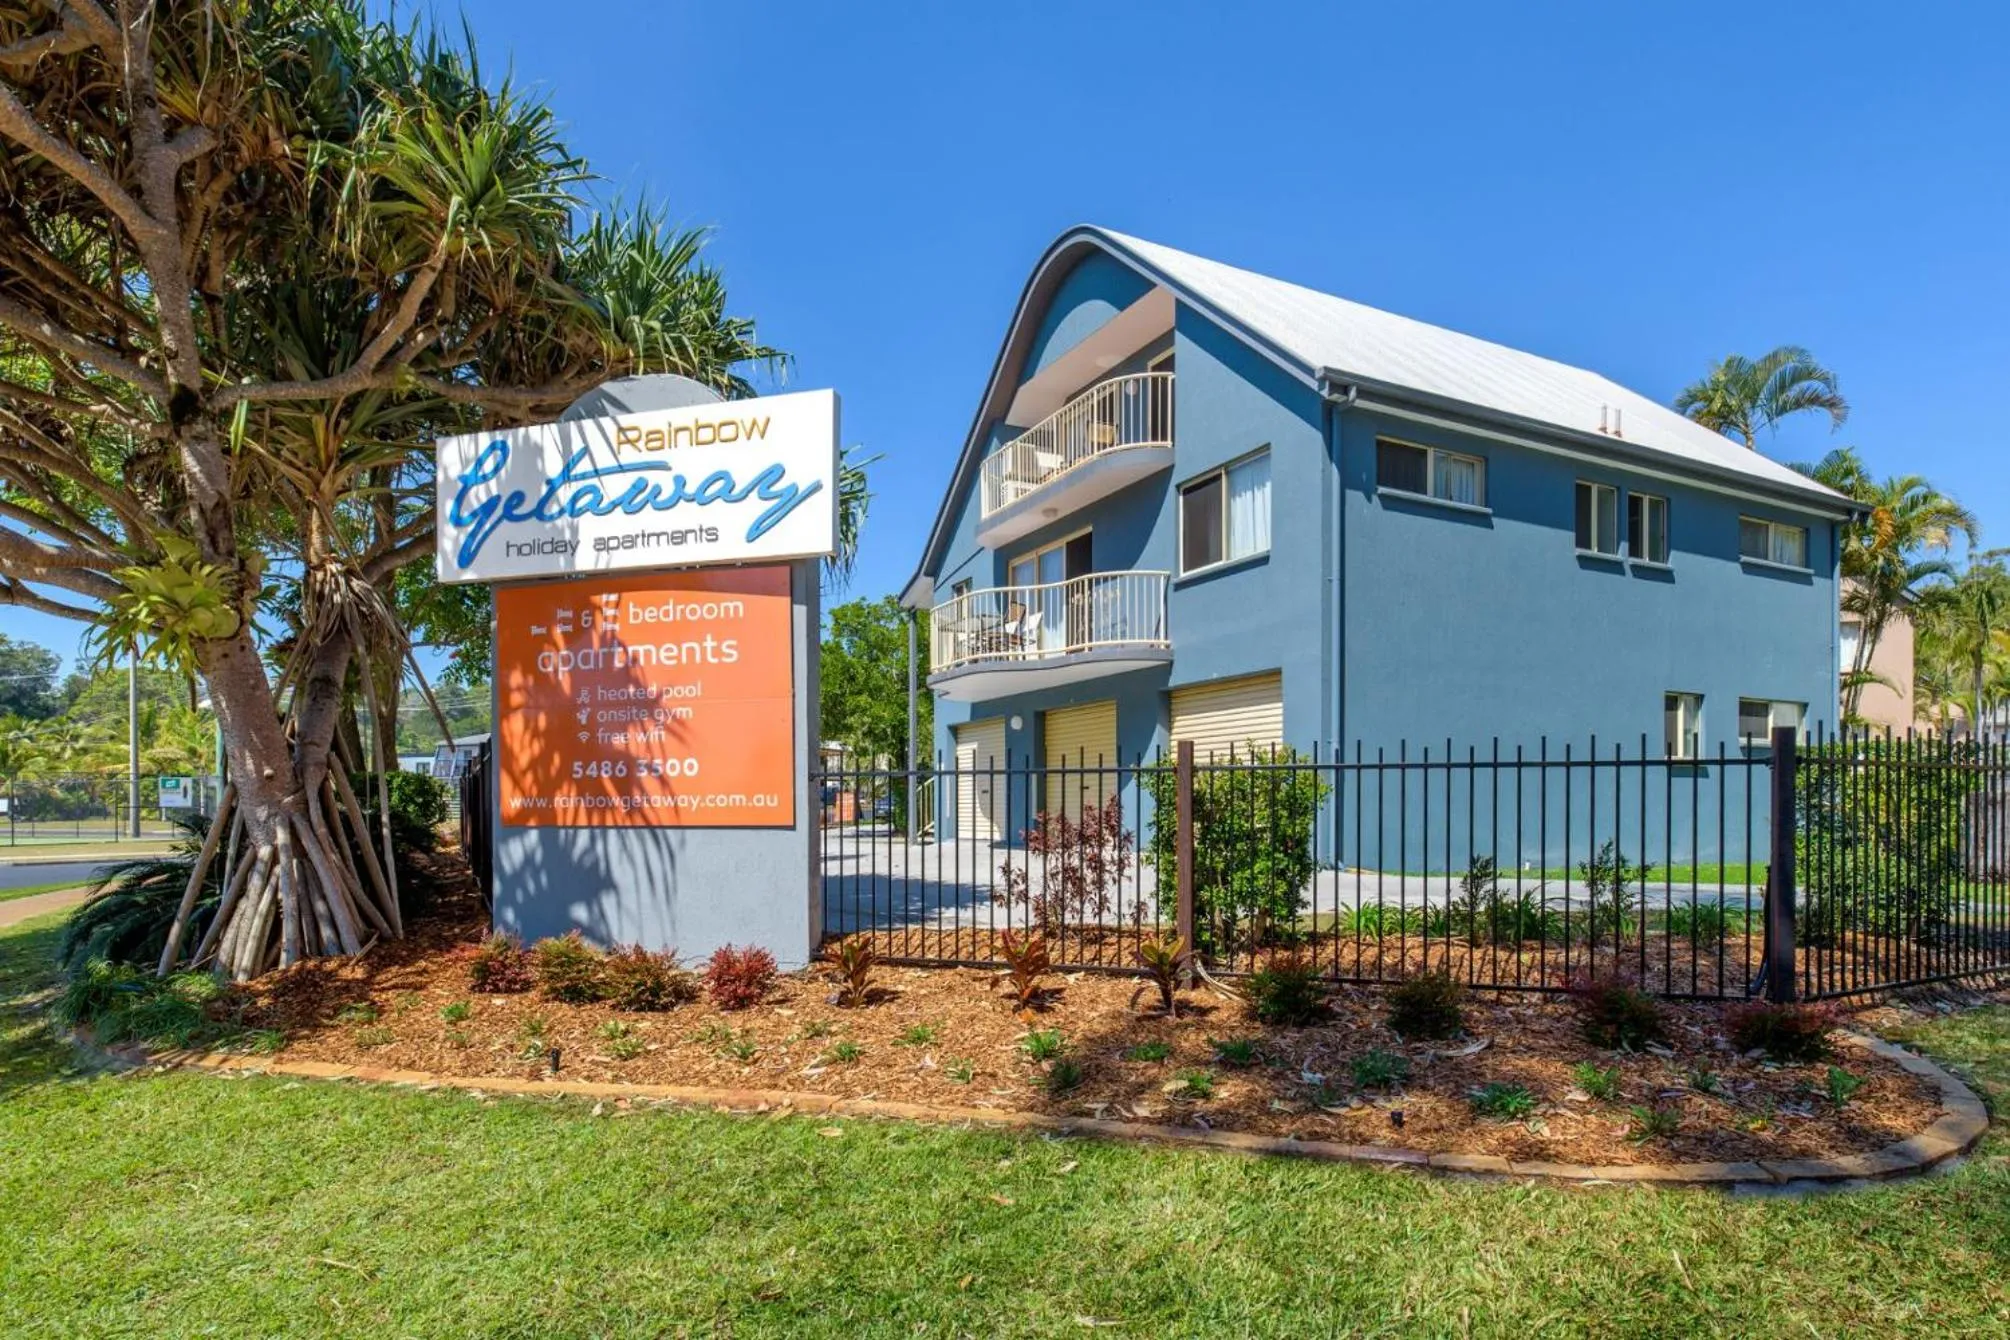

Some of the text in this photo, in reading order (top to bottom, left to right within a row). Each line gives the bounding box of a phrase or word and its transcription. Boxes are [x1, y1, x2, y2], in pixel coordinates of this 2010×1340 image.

[616, 416, 771, 454] Rainbow
[448, 438, 823, 570] Getaway
[506, 524, 719, 559] holiday apartments
[581, 599, 744, 628] & bedroom
[537, 633, 739, 681] apartments
[597, 681, 702, 704] heated pool
[597, 706, 693, 726] onsite gym
[597, 725, 666, 745] free wifi
[572, 757, 700, 779] 5486 3500
[508, 791, 780, 814] www.rainbowgetaway.com.au
